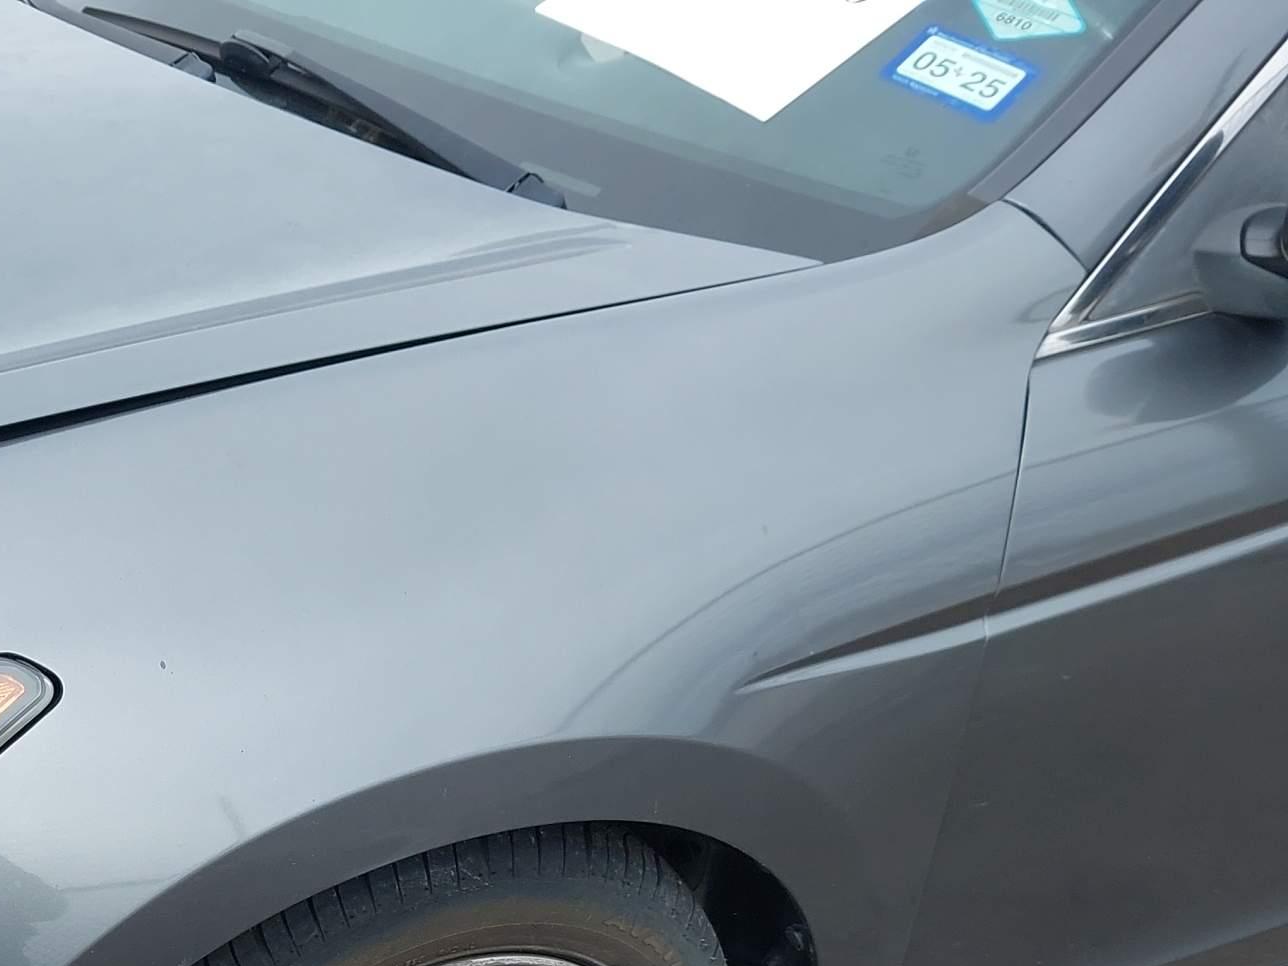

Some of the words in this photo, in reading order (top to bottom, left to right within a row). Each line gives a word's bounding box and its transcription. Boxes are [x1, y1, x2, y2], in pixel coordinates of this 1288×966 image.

[995, 11, 1033, 31] 6810
[912, 51, 957, 78] 05
[959, 71, 1007, 99] 25
